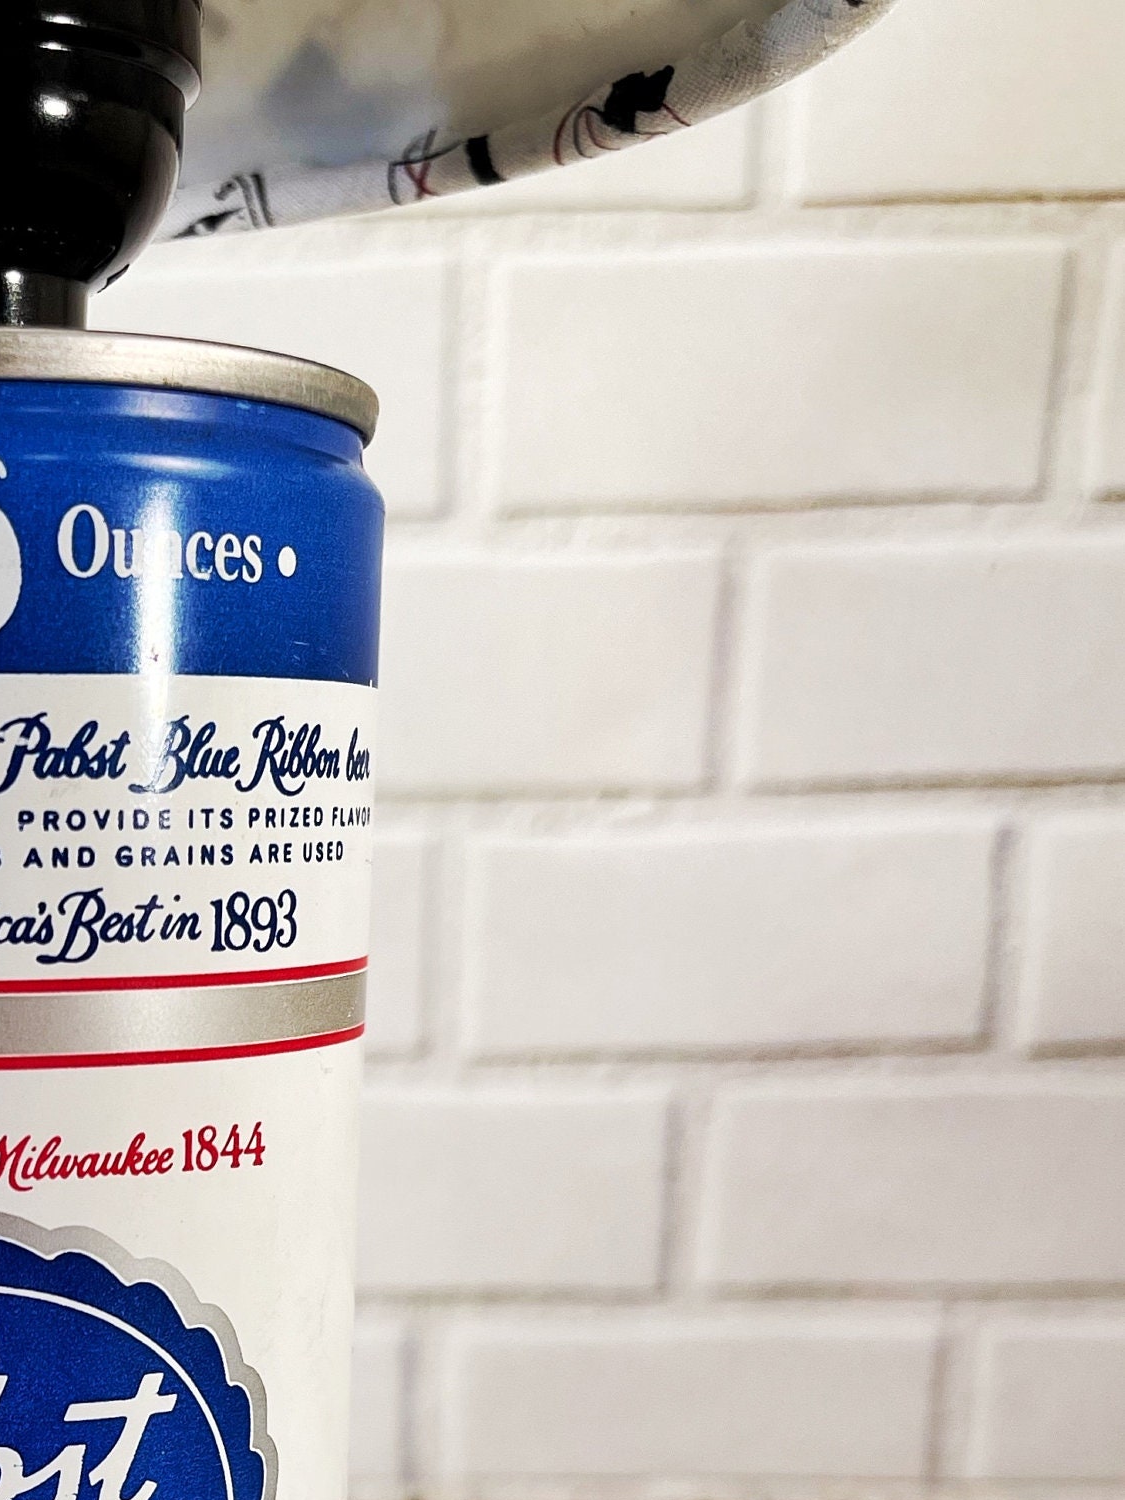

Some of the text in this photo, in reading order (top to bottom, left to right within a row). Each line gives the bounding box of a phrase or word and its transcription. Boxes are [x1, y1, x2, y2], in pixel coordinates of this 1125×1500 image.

[128, 715, 242, 794] Blue
[235, 715, 341, 797] Ribbon
[18, 808, 172, 832] PROVIDE
[188, 808, 234, 830] ITS
[248, 806, 325, 830] PRIZED
[22, 847, 97, 869] AND
[115, 845, 235, 869] GRAINS
[249, 843, 293, 864] ARE
[303, 840, 344, 862] USED
[35, 887, 165, 965] Best
[161, 894, 202, 942] in
[210, 888, 298, 953] 1893
[182, 1121, 266, 1172] 1844
